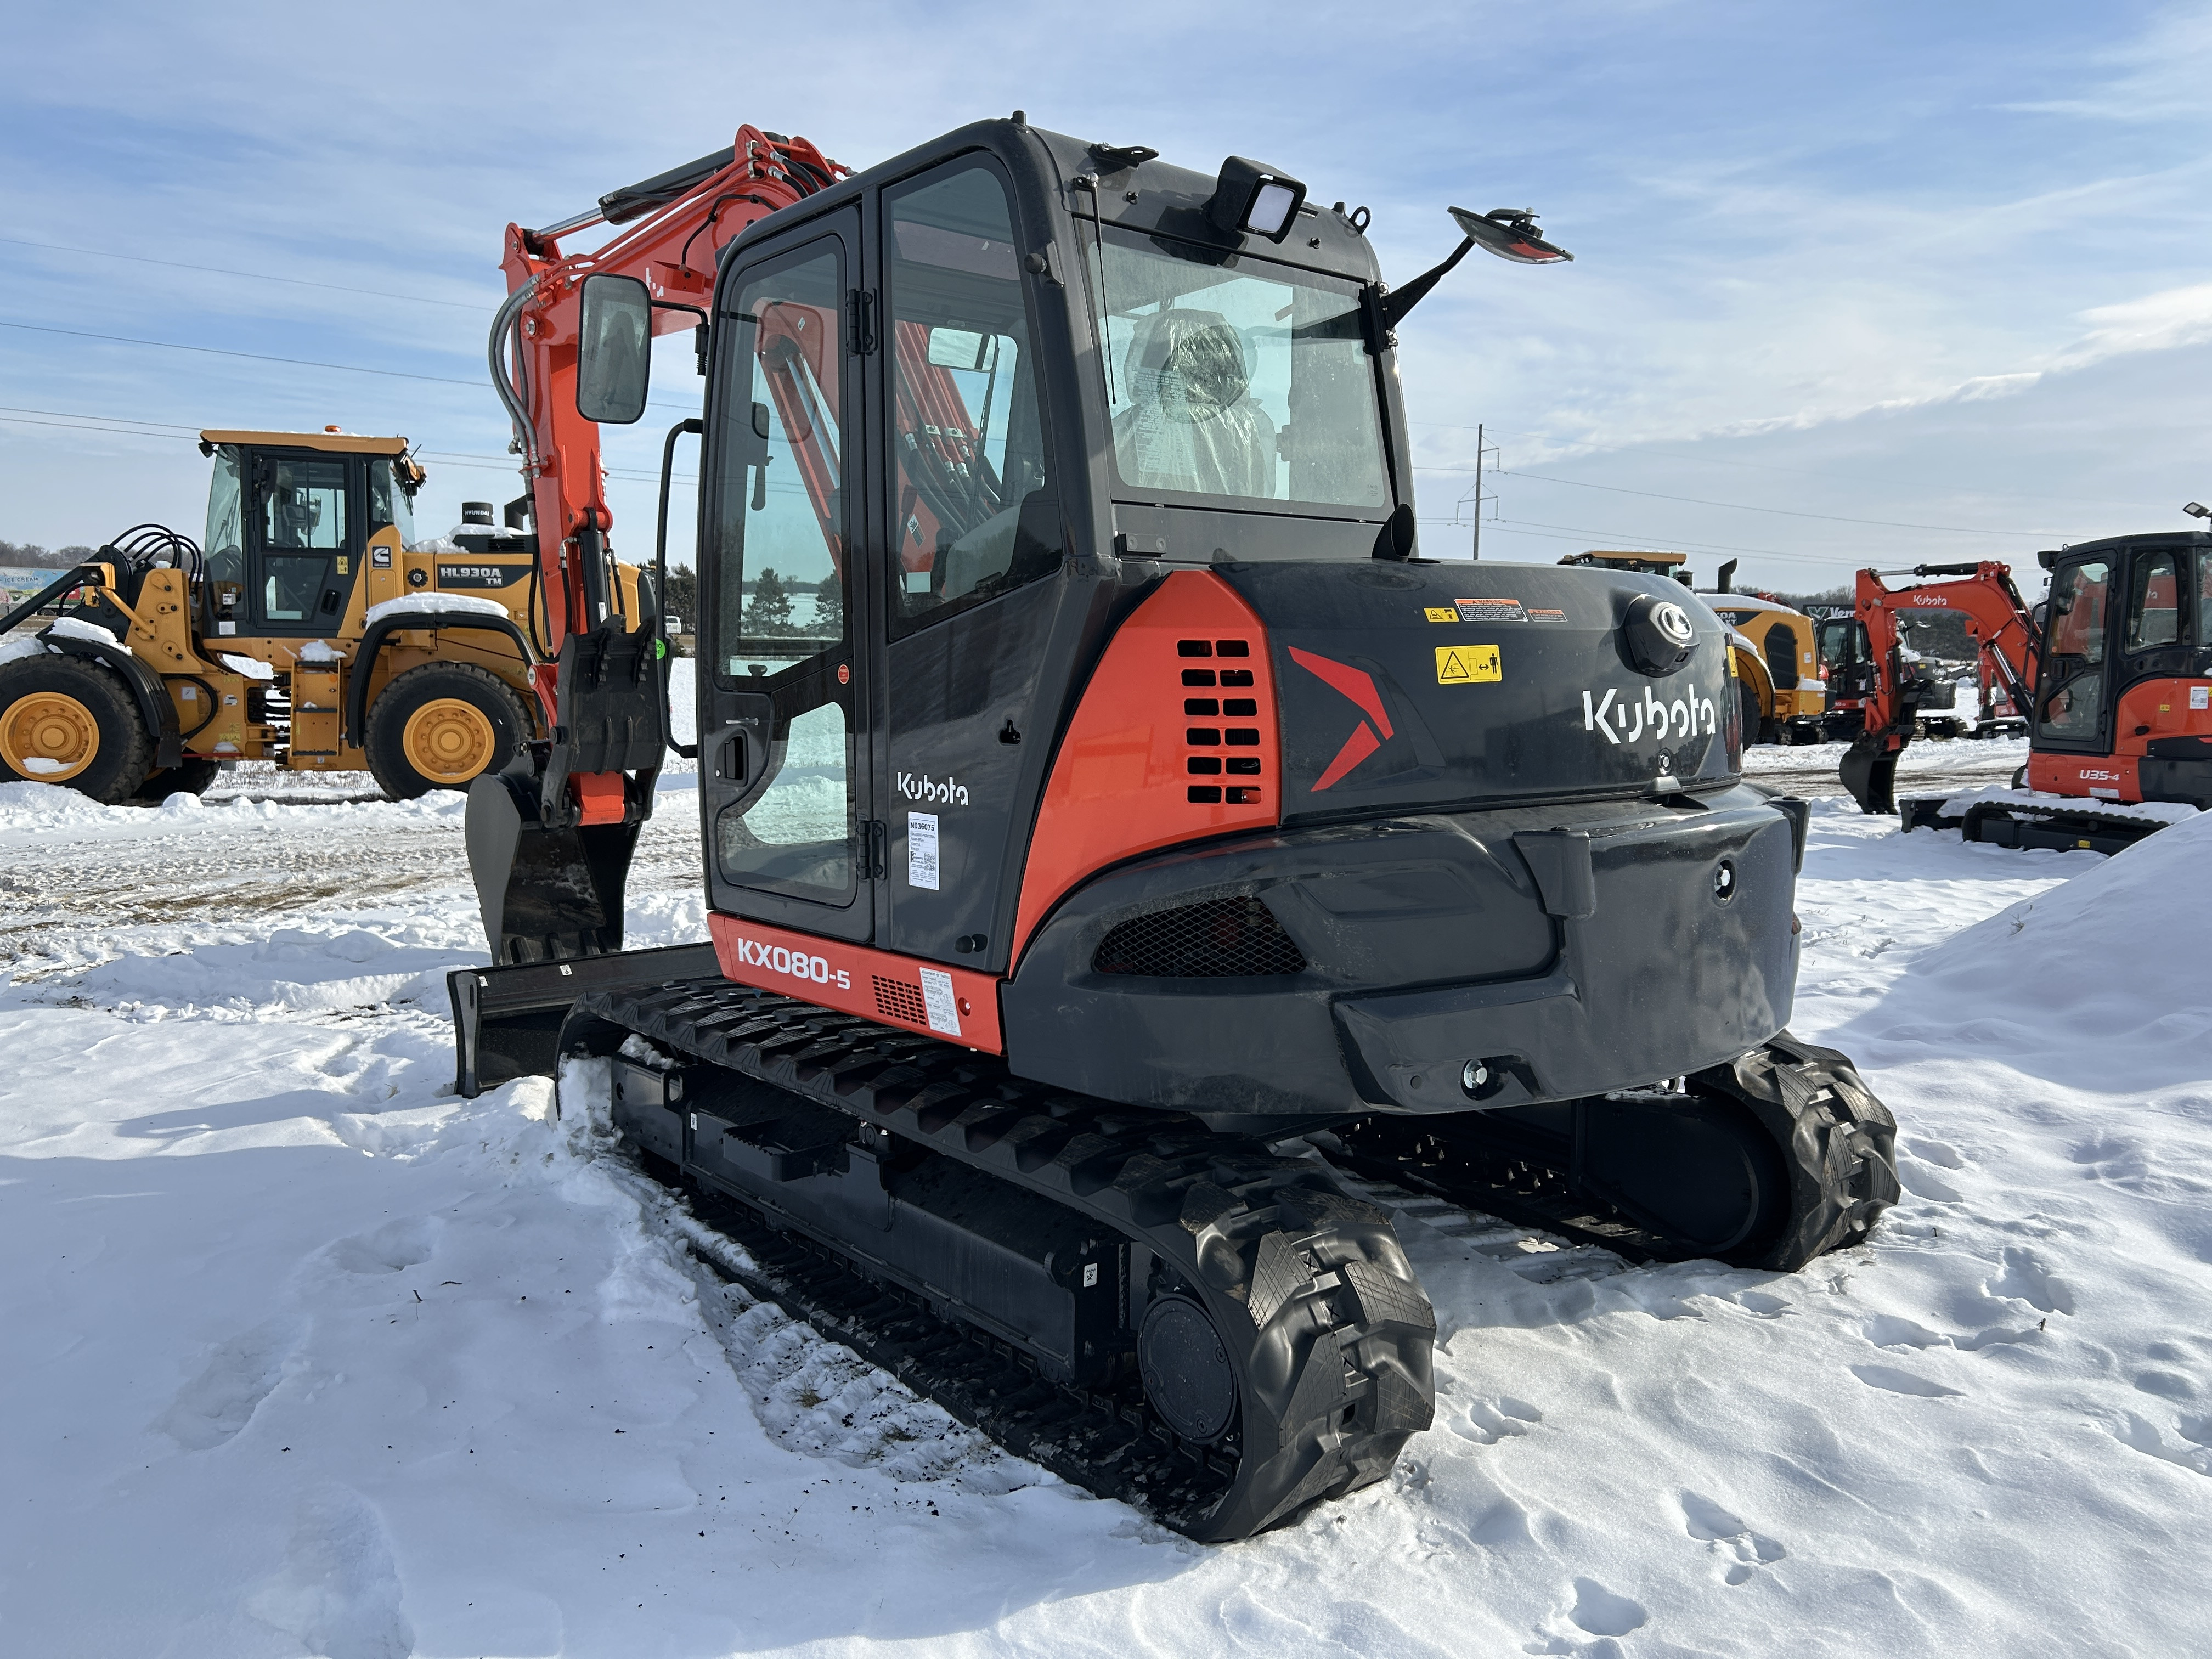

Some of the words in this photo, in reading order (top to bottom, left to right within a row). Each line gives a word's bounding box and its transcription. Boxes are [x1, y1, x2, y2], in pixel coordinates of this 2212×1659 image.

[441, 567, 502, 578] HL930A
[1913, 595, 1948, 606] Kubota
[1582, 684, 1716, 744] Kubota
[2080, 769, 2119, 781] U35-4
[897, 772, 969, 805] Kubota
[910, 822, 935, 831] N036075
[738, 938, 851, 990] KX080-5
